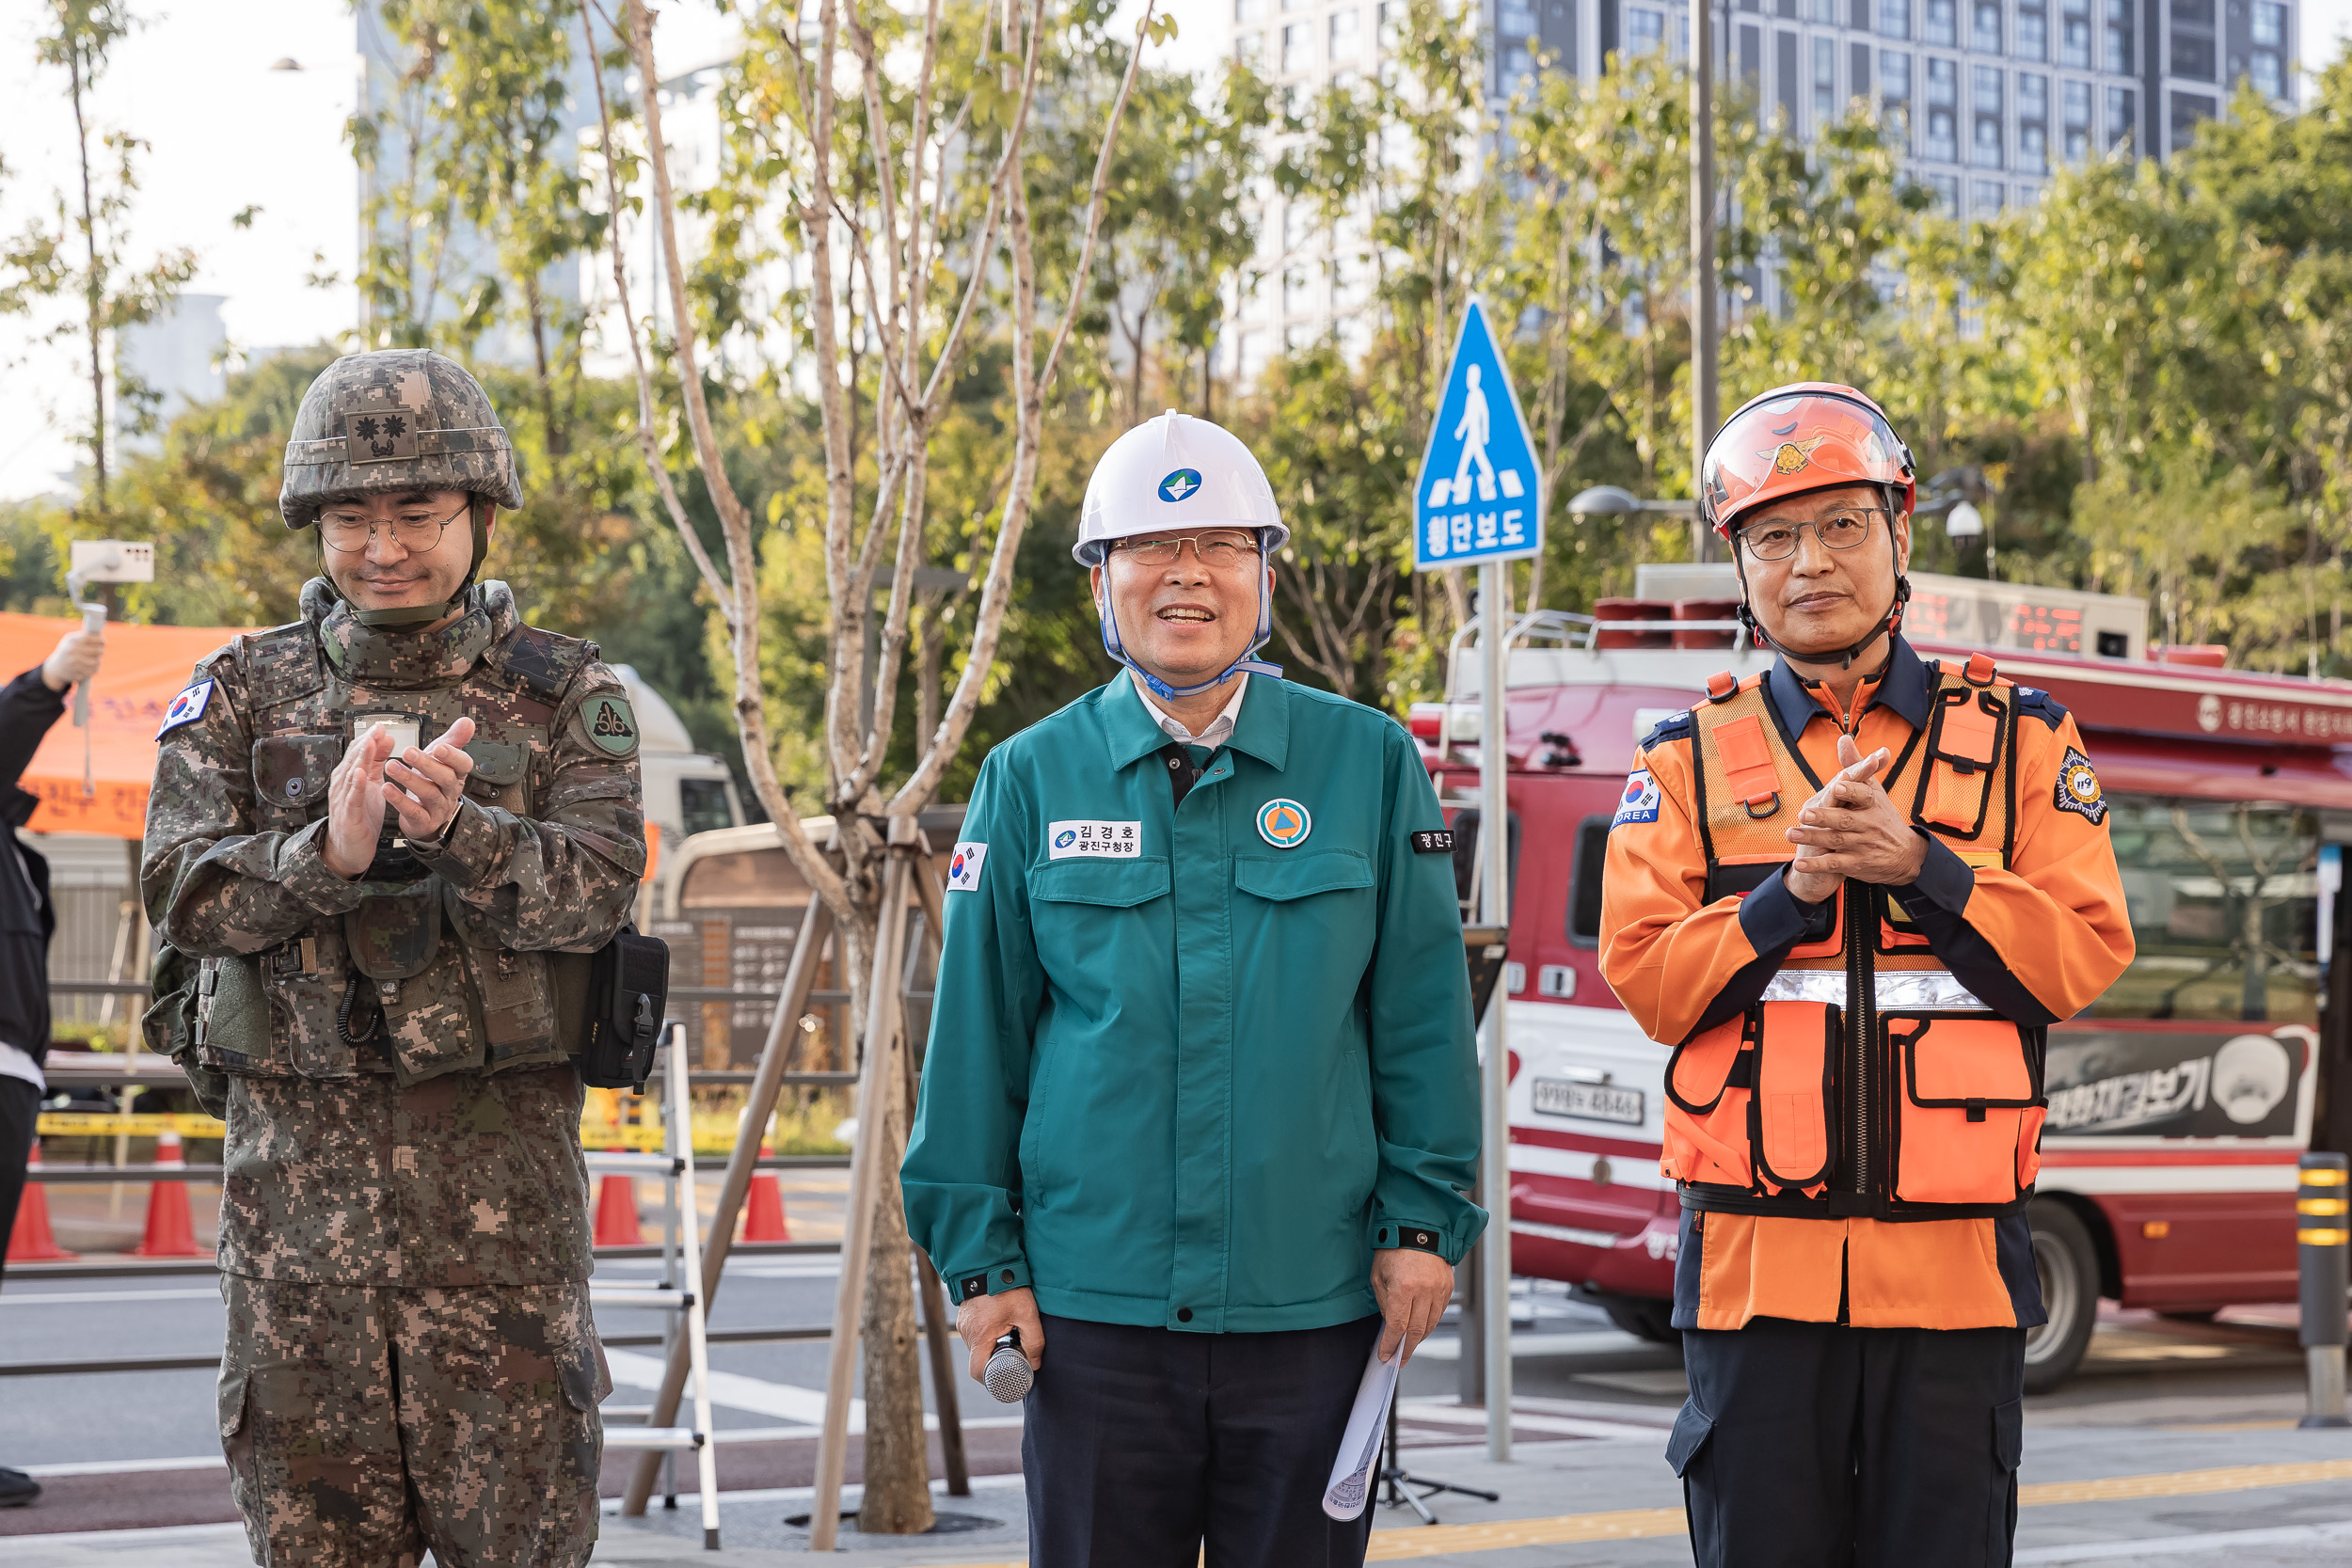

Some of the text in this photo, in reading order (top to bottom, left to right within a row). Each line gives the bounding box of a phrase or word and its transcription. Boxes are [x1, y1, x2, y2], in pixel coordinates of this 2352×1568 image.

[1426, 509, 1525, 557] 횡단보도
[2076, 777, 2092, 791] 119
[1614, 810, 1651, 824] OREA
[1421, 832, 1453, 847] 광진구
[1078, 841, 1134, 853] 광진구청장
